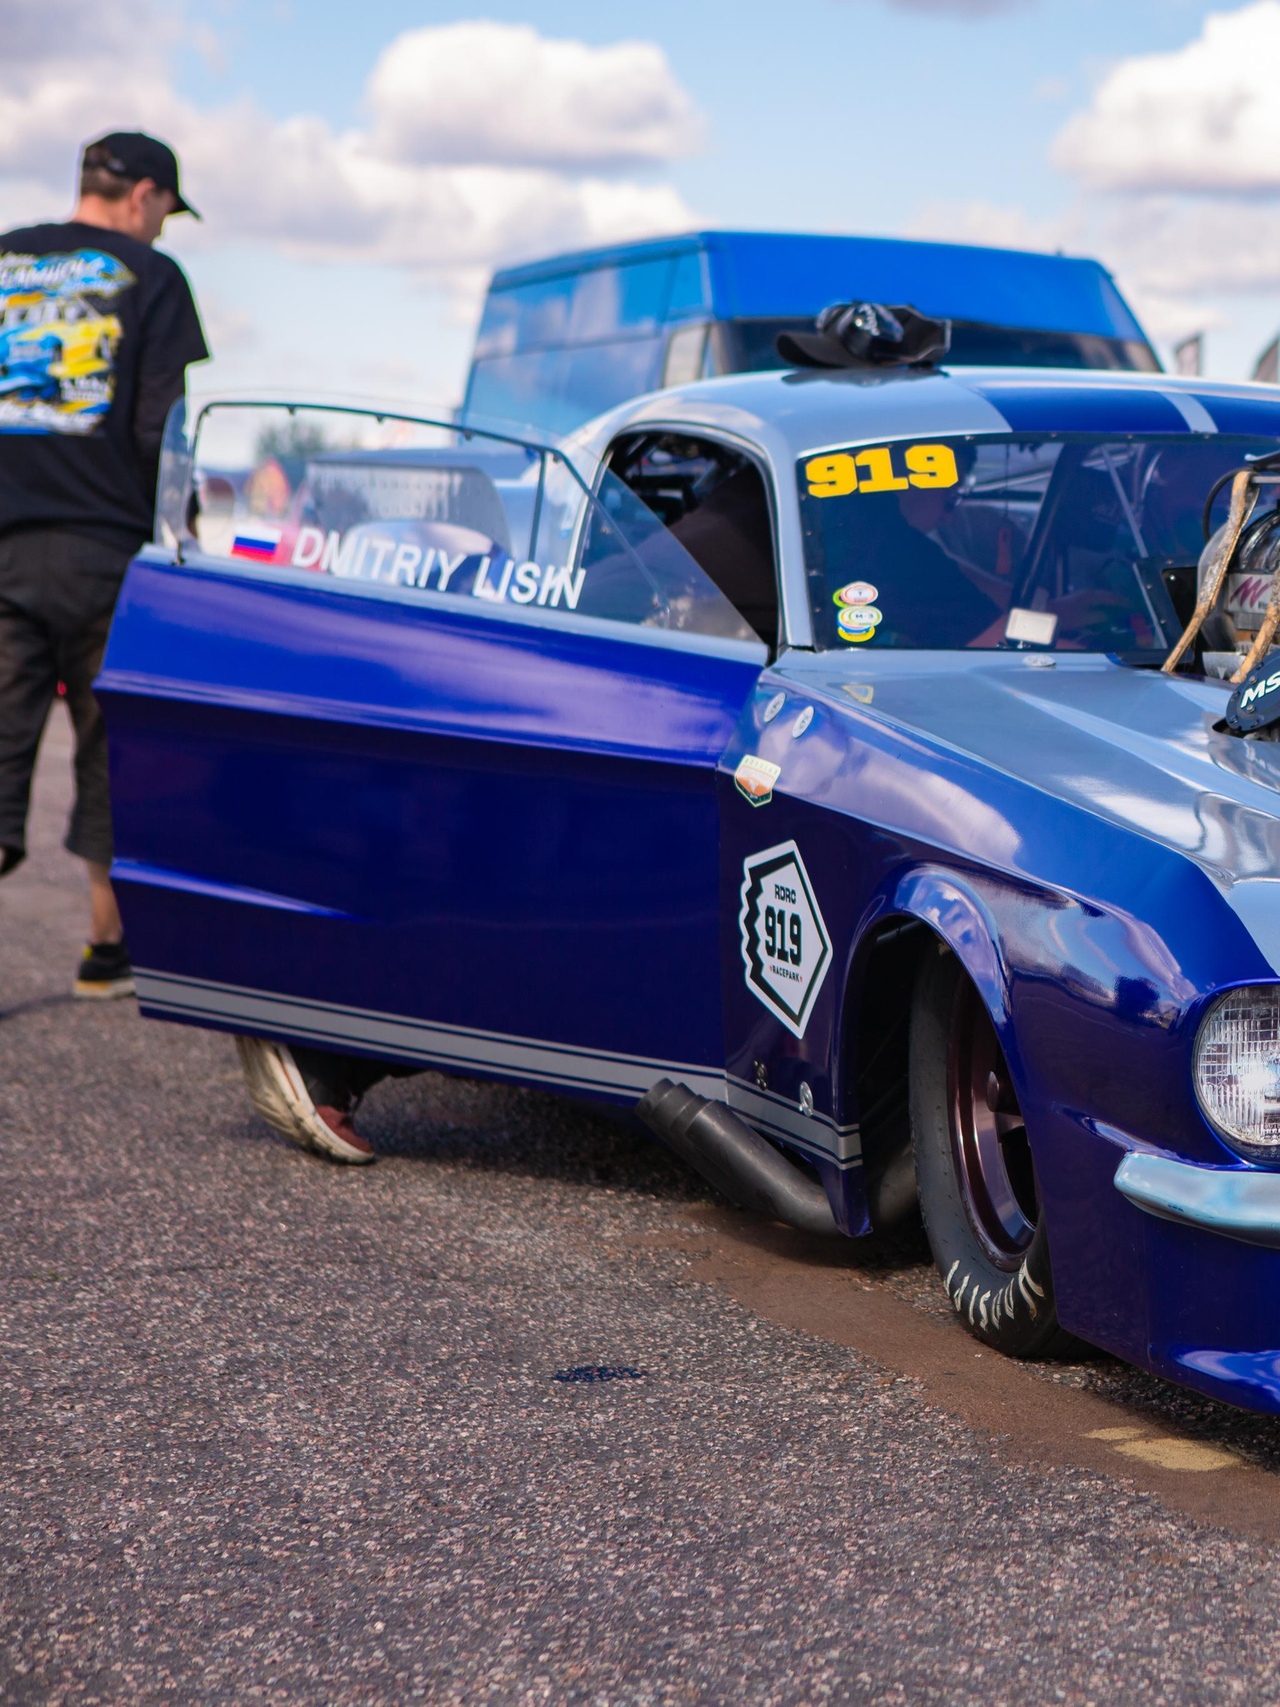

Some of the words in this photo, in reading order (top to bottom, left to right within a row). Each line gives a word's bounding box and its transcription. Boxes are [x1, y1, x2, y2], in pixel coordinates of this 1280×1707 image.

[805, 444, 958, 498] 919
[291, 528, 467, 592] DMITRIY
[472, 556, 587, 610] LISIN
[774, 884, 796, 904] RDRC
[765, 905, 801, 967] 919
[772, 966, 799, 981] RACEPARK
